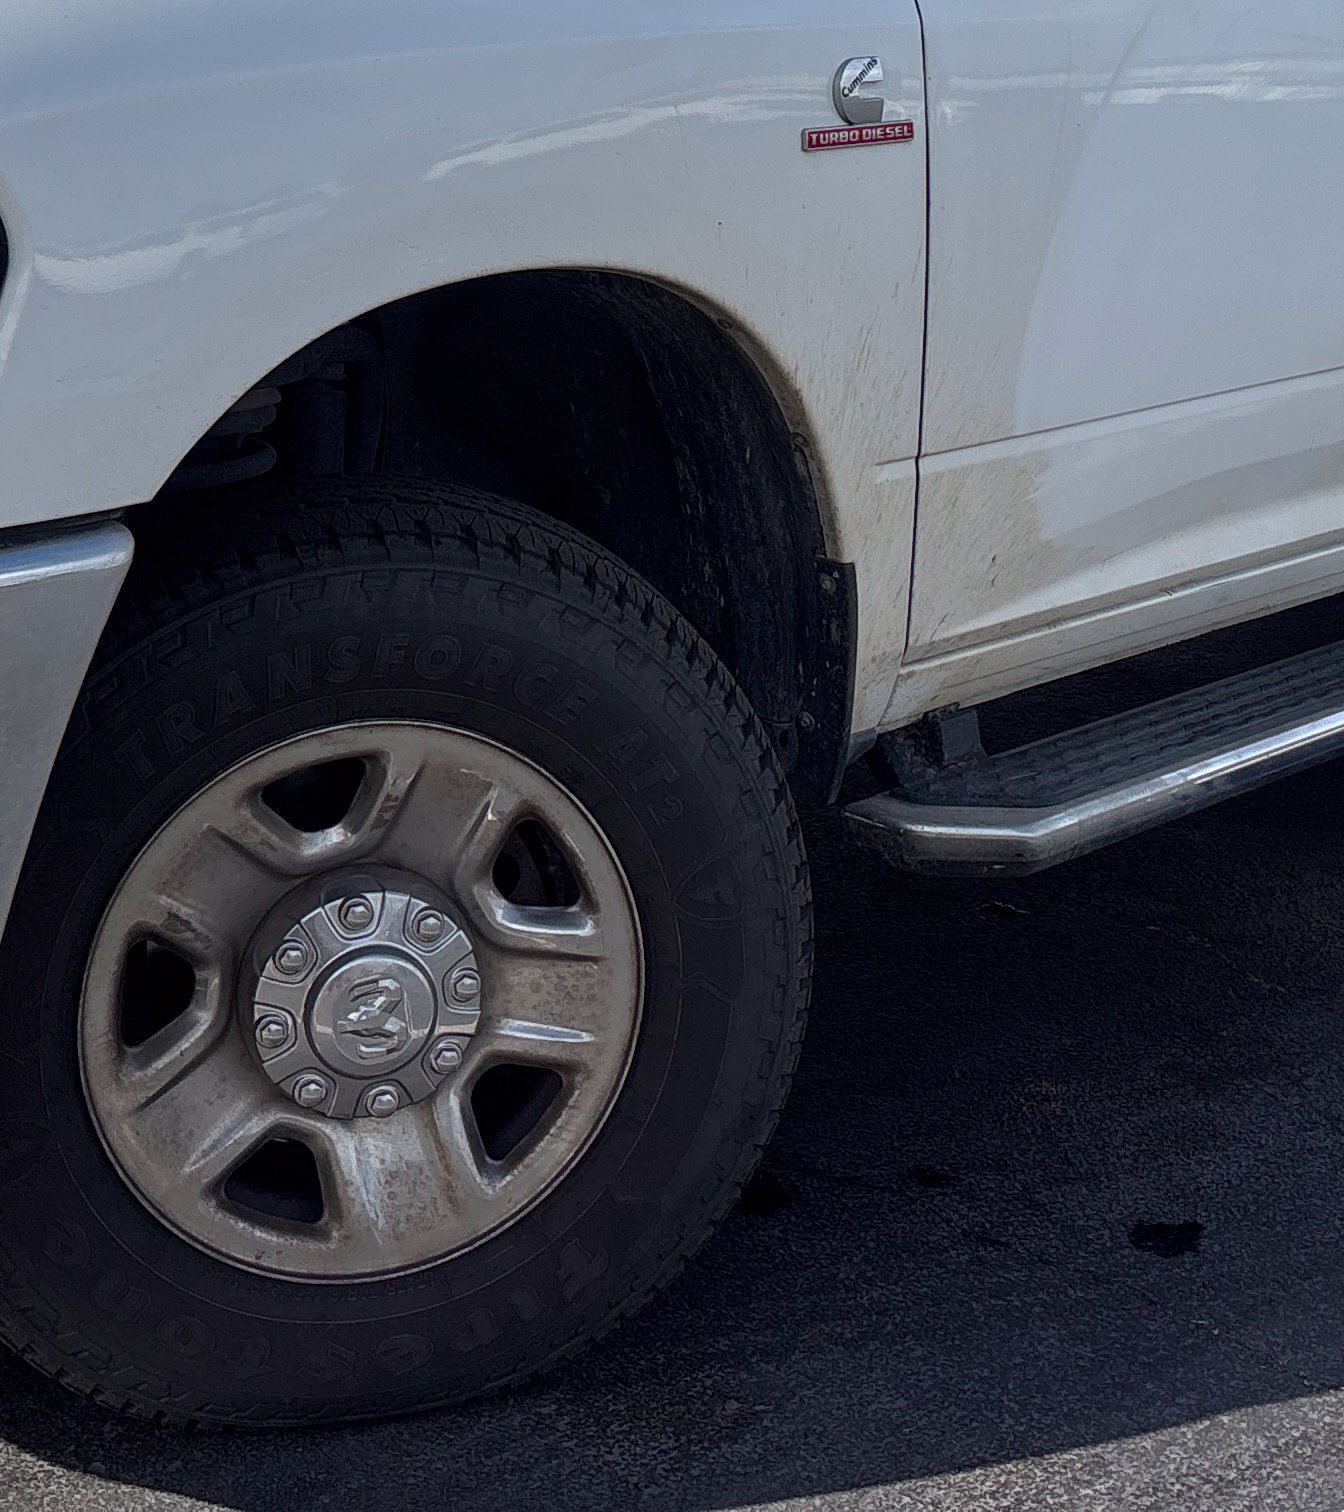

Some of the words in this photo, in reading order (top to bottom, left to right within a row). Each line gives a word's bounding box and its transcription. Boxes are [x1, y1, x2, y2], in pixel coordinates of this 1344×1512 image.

[841, 57, 878, 98] Cummins
[809, 129, 860, 146] TURBO
[862, 124, 913, 140] DIESEL
[111, 631, 601, 782] TRANSFORCE
